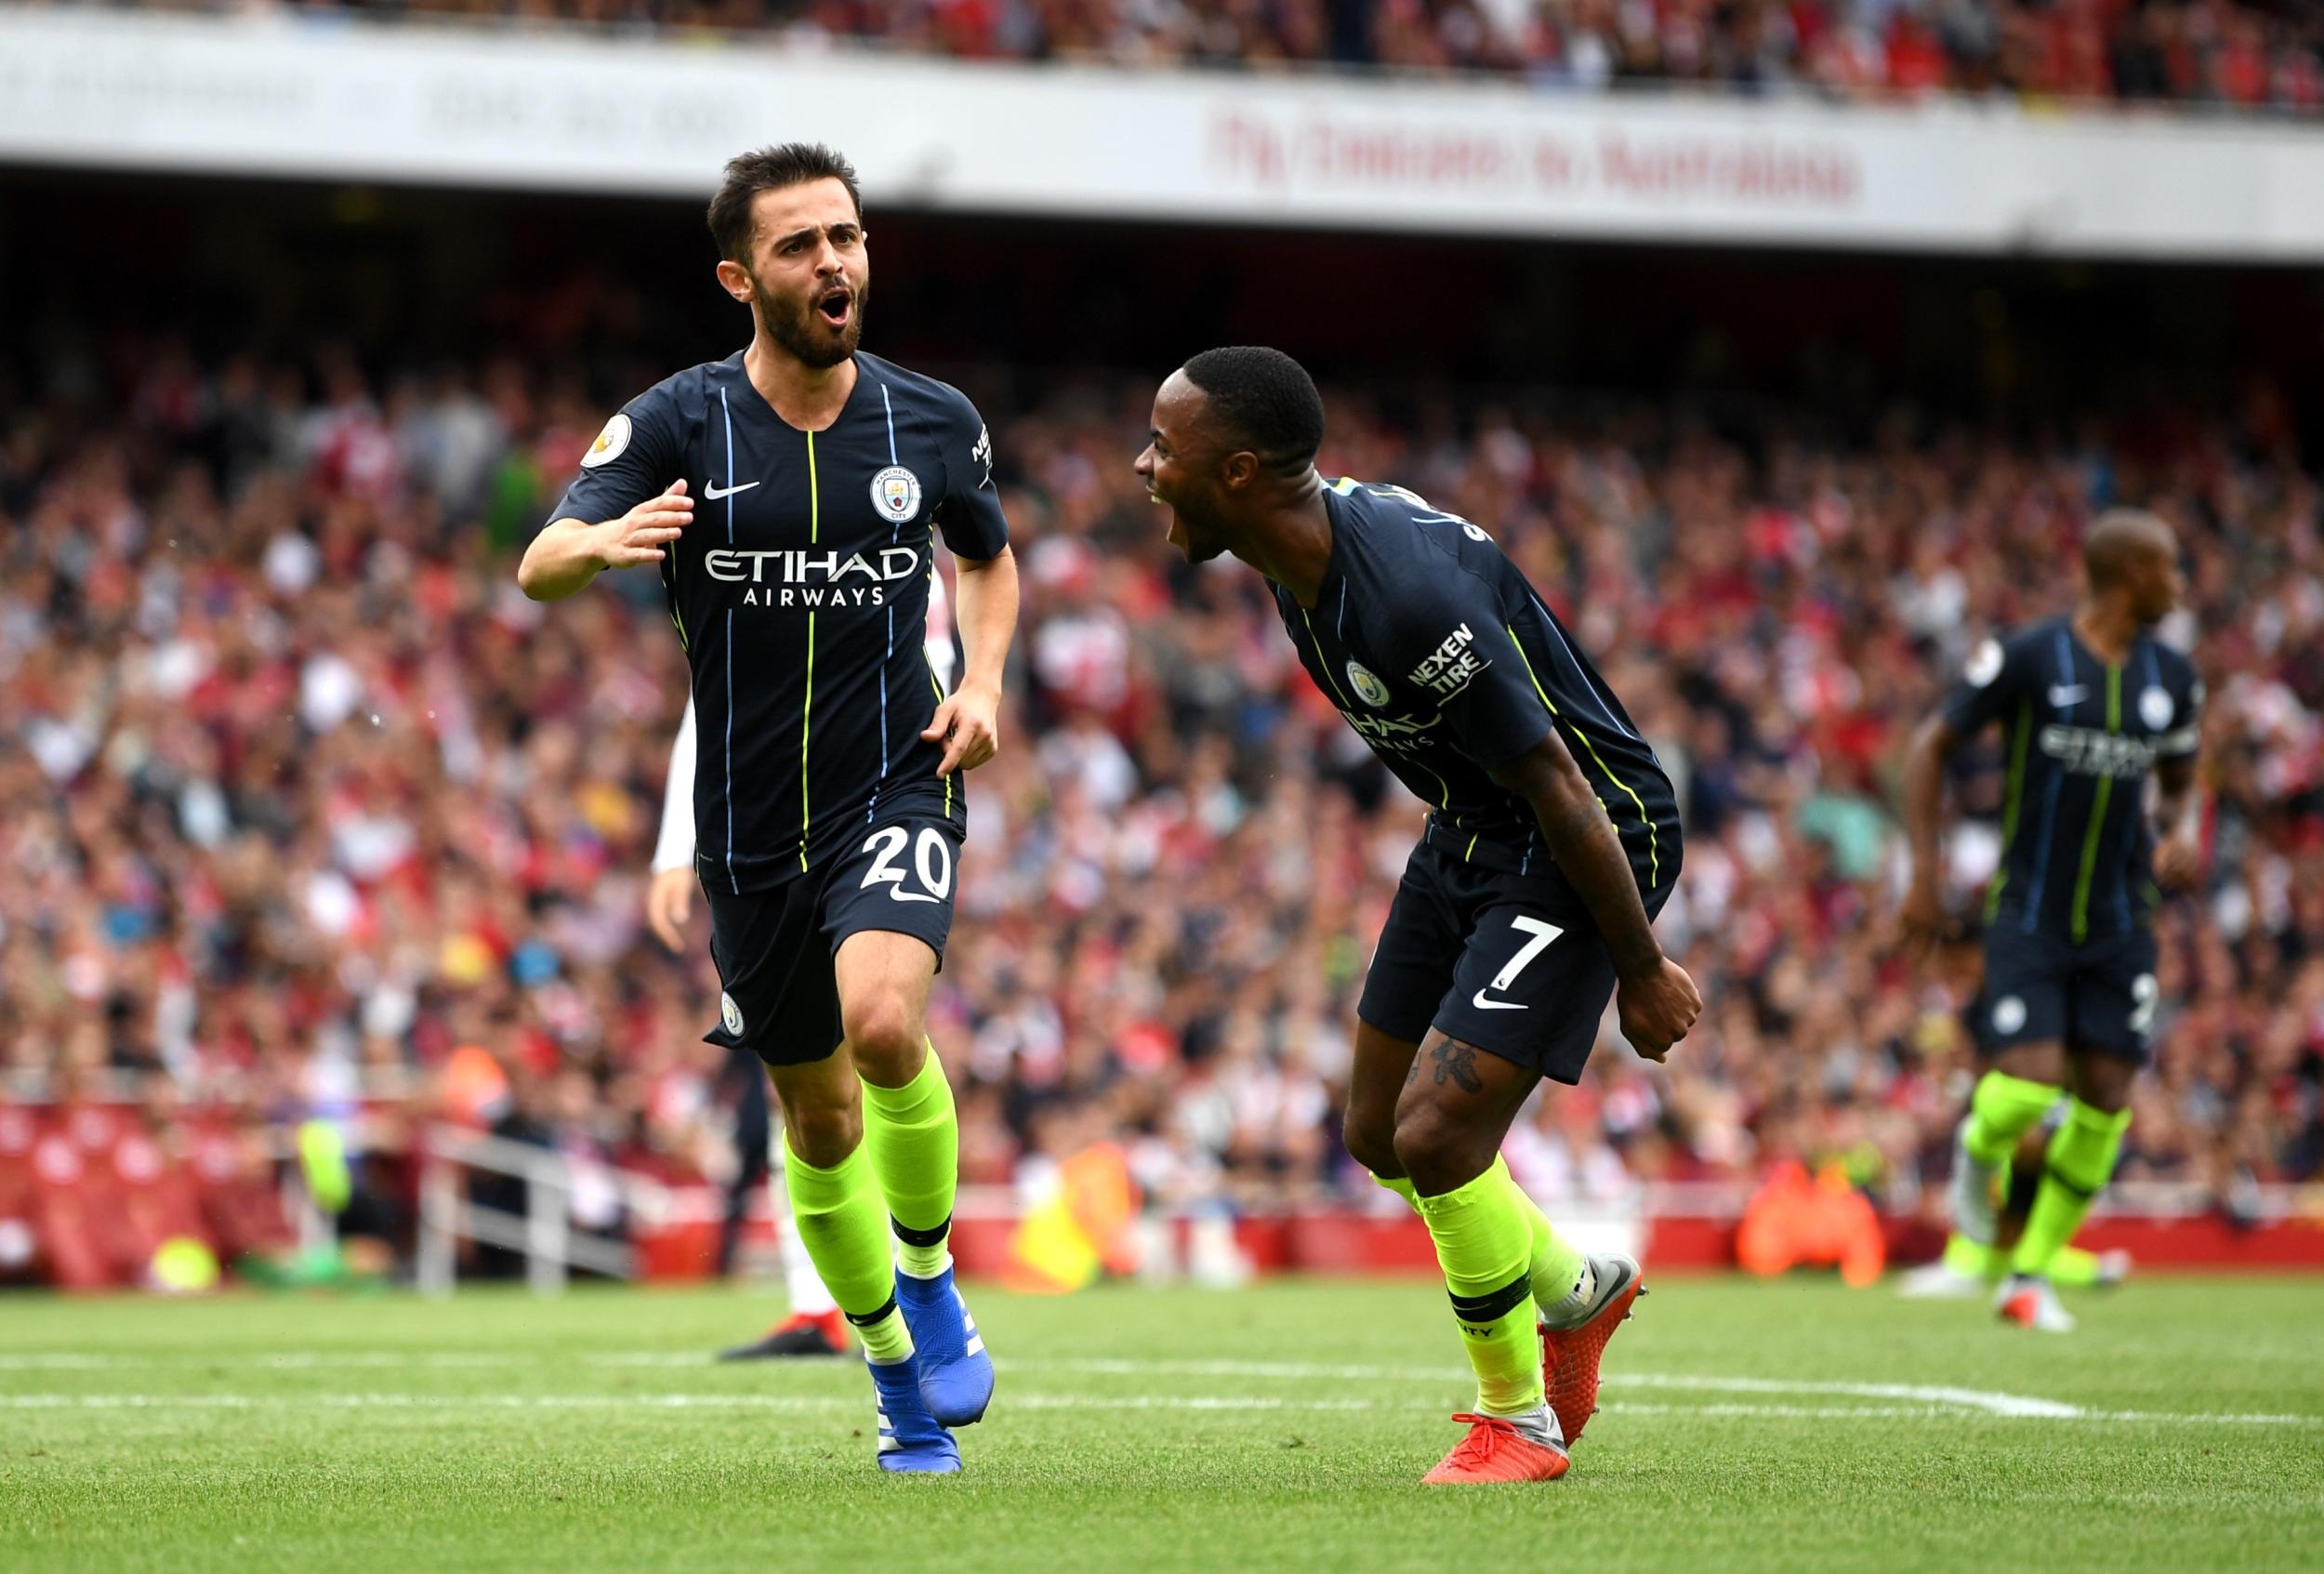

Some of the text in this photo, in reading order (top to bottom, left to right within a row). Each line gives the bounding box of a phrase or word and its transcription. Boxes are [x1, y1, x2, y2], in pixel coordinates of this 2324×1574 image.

[705, 548, 918, 583] ETIHAD
[744, 587, 883, 606] AIRWAYS
[1407, 622, 1474, 686] NEXEN
[1429, 650, 1481, 694] TIRE
[860, 826, 951, 899] 20
[1490, 915, 1565, 991] 7
